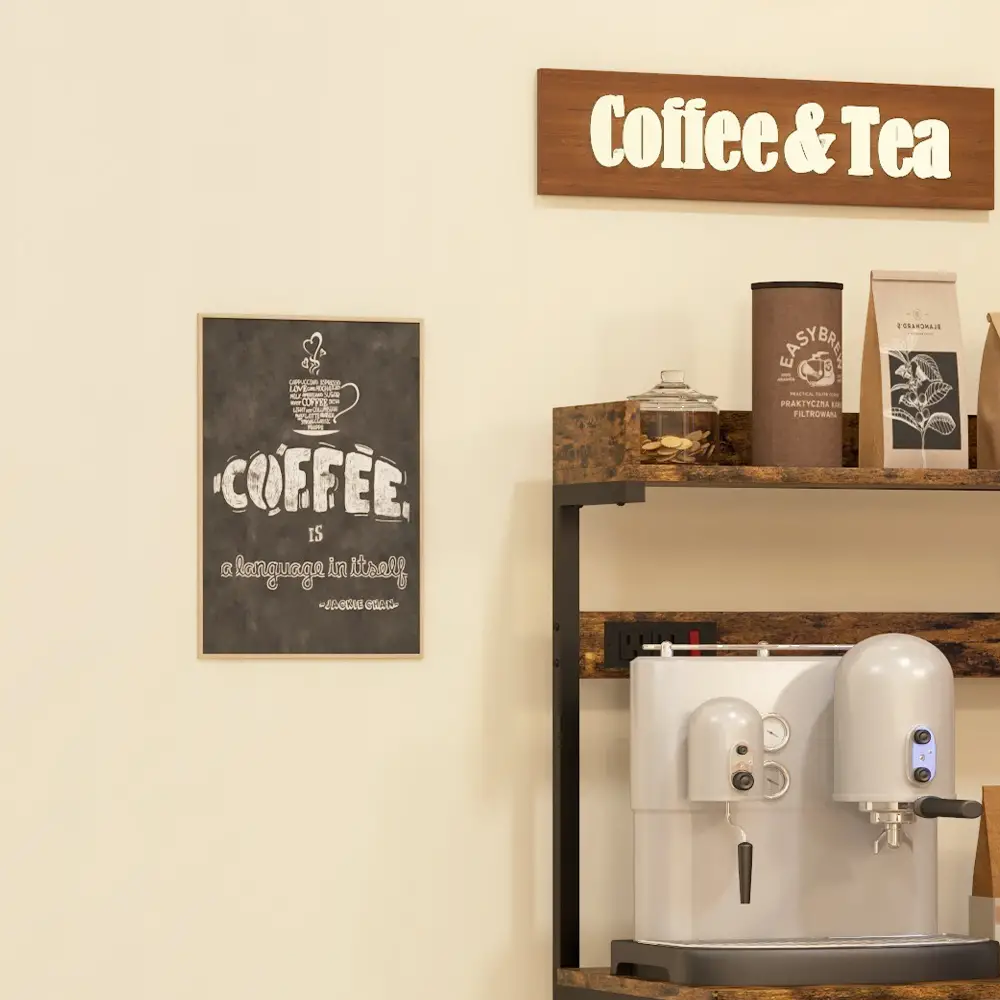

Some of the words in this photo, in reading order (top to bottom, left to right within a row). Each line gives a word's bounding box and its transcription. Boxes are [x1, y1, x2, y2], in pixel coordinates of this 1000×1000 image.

[590, 94, 779, 173] Coffee
[841, 106, 952, 180] Tea
[780, 400, 829, 408] PRAKTYCZNA
[308, 524, 324, 542] IS
[220, 561, 233, 578] a
[235, 554, 325, 590] language
[328, 557, 347, 578] in
[350, 554, 408, 590] itself
